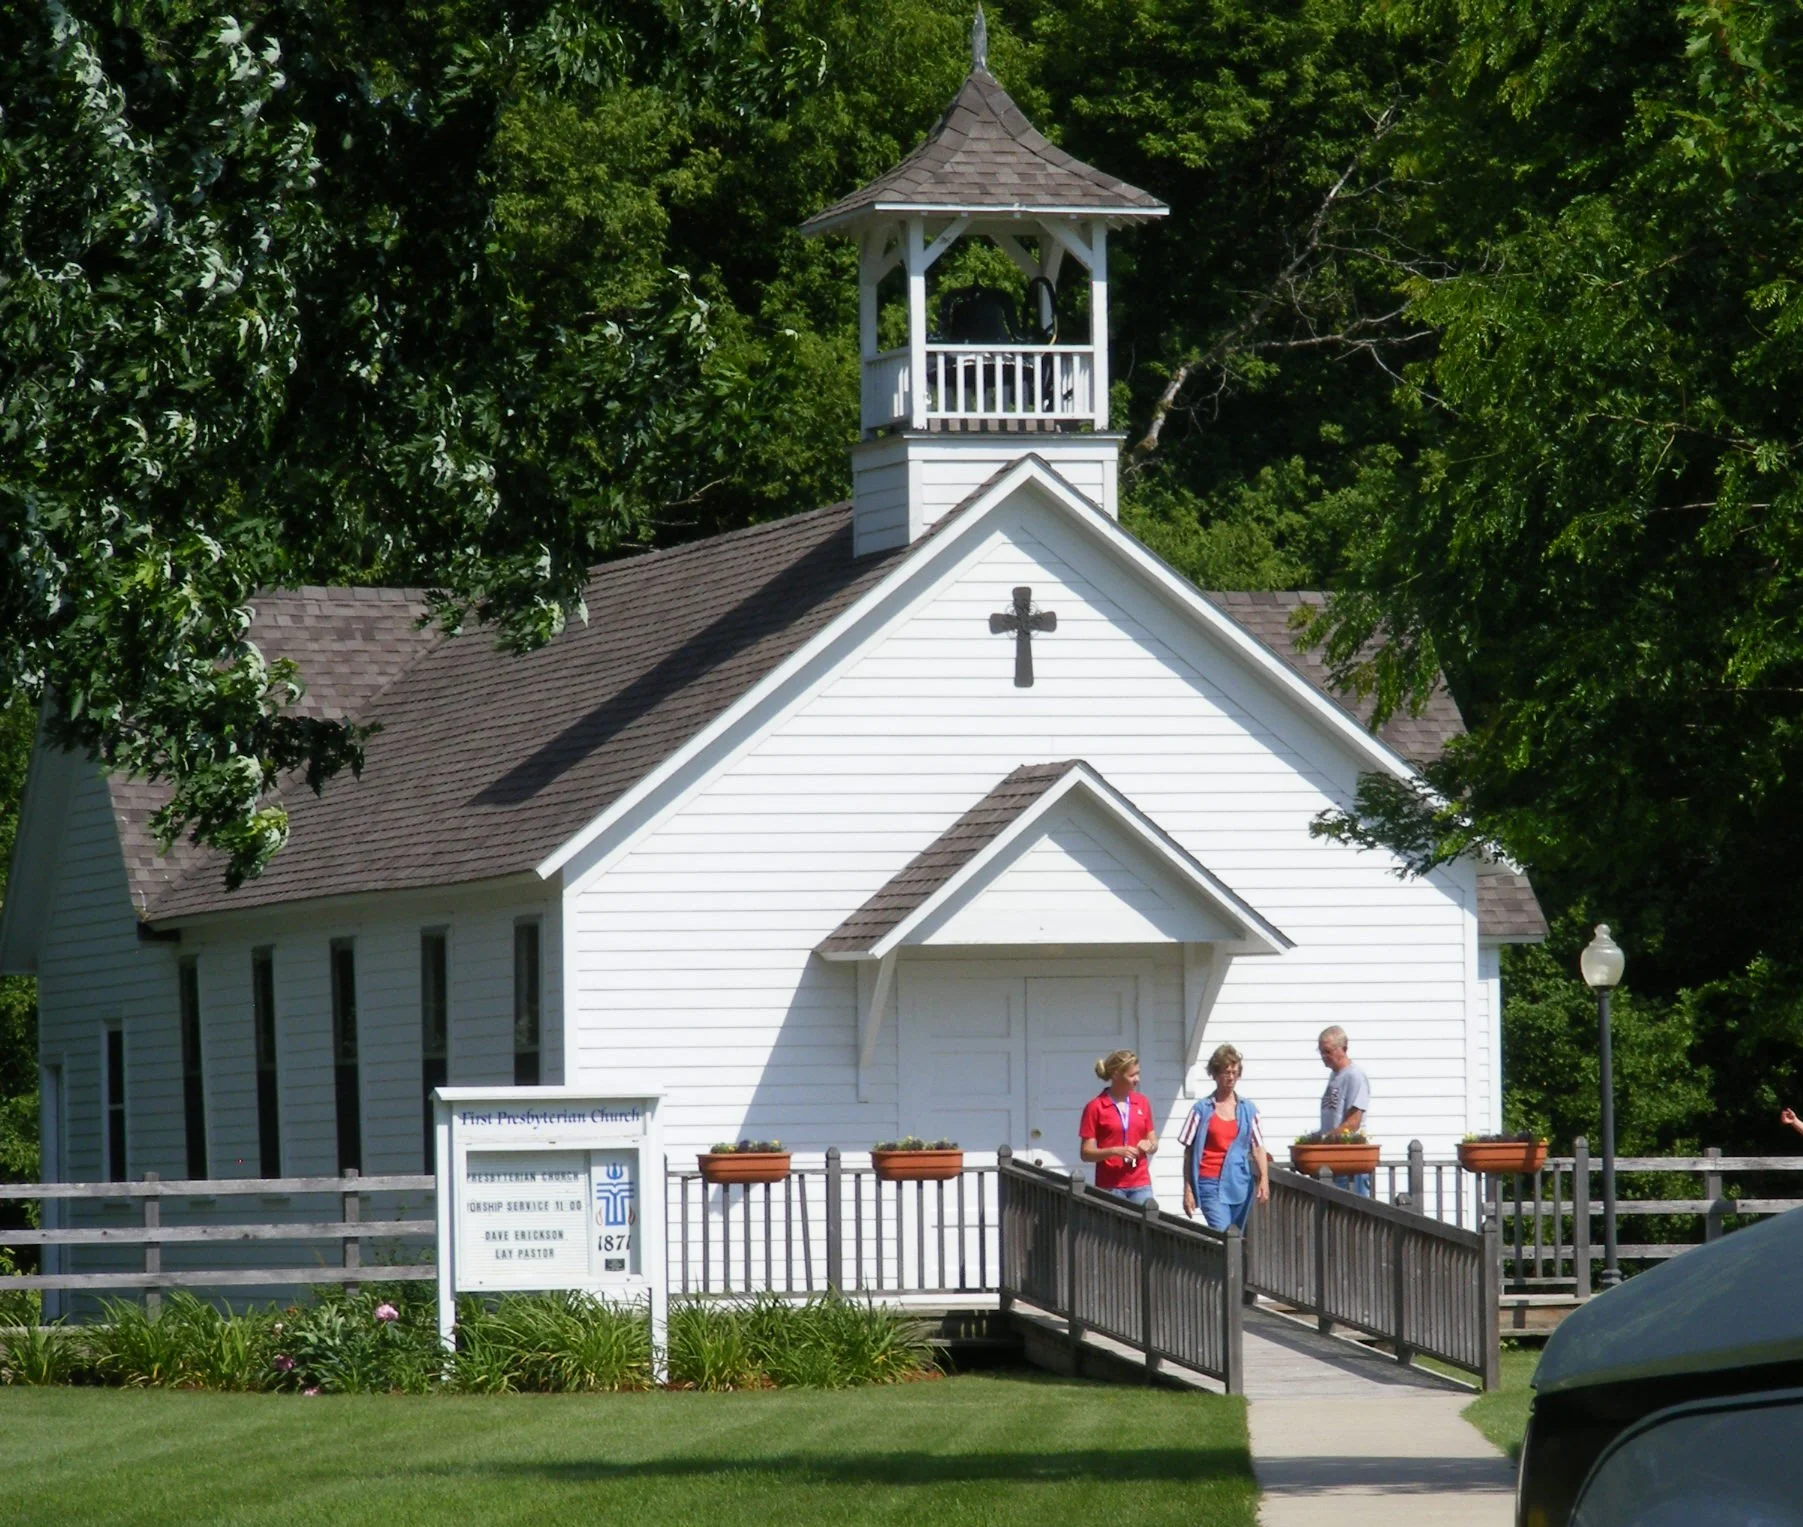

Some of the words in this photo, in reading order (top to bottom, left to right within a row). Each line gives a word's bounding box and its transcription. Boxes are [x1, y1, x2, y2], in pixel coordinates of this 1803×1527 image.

[462, 1111, 492, 1125] First
[498, 1107, 586, 1127] Presbyterian
[590, 1107, 640, 1124] Church
[466, 1172, 536, 1182] PRESBYTERIAN
[541, 1171, 579, 1182] CHURCH
[467, 1201, 503, 1213] ORSHIP
[507, 1201, 549, 1212] SERVICE
[485, 1231, 509, 1241] DAVE
[514, 1230, 564, 1241] ERICKSON
[495, 1249, 513, 1260] LAY
[518, 1248, 555, 1259] PASTOR
